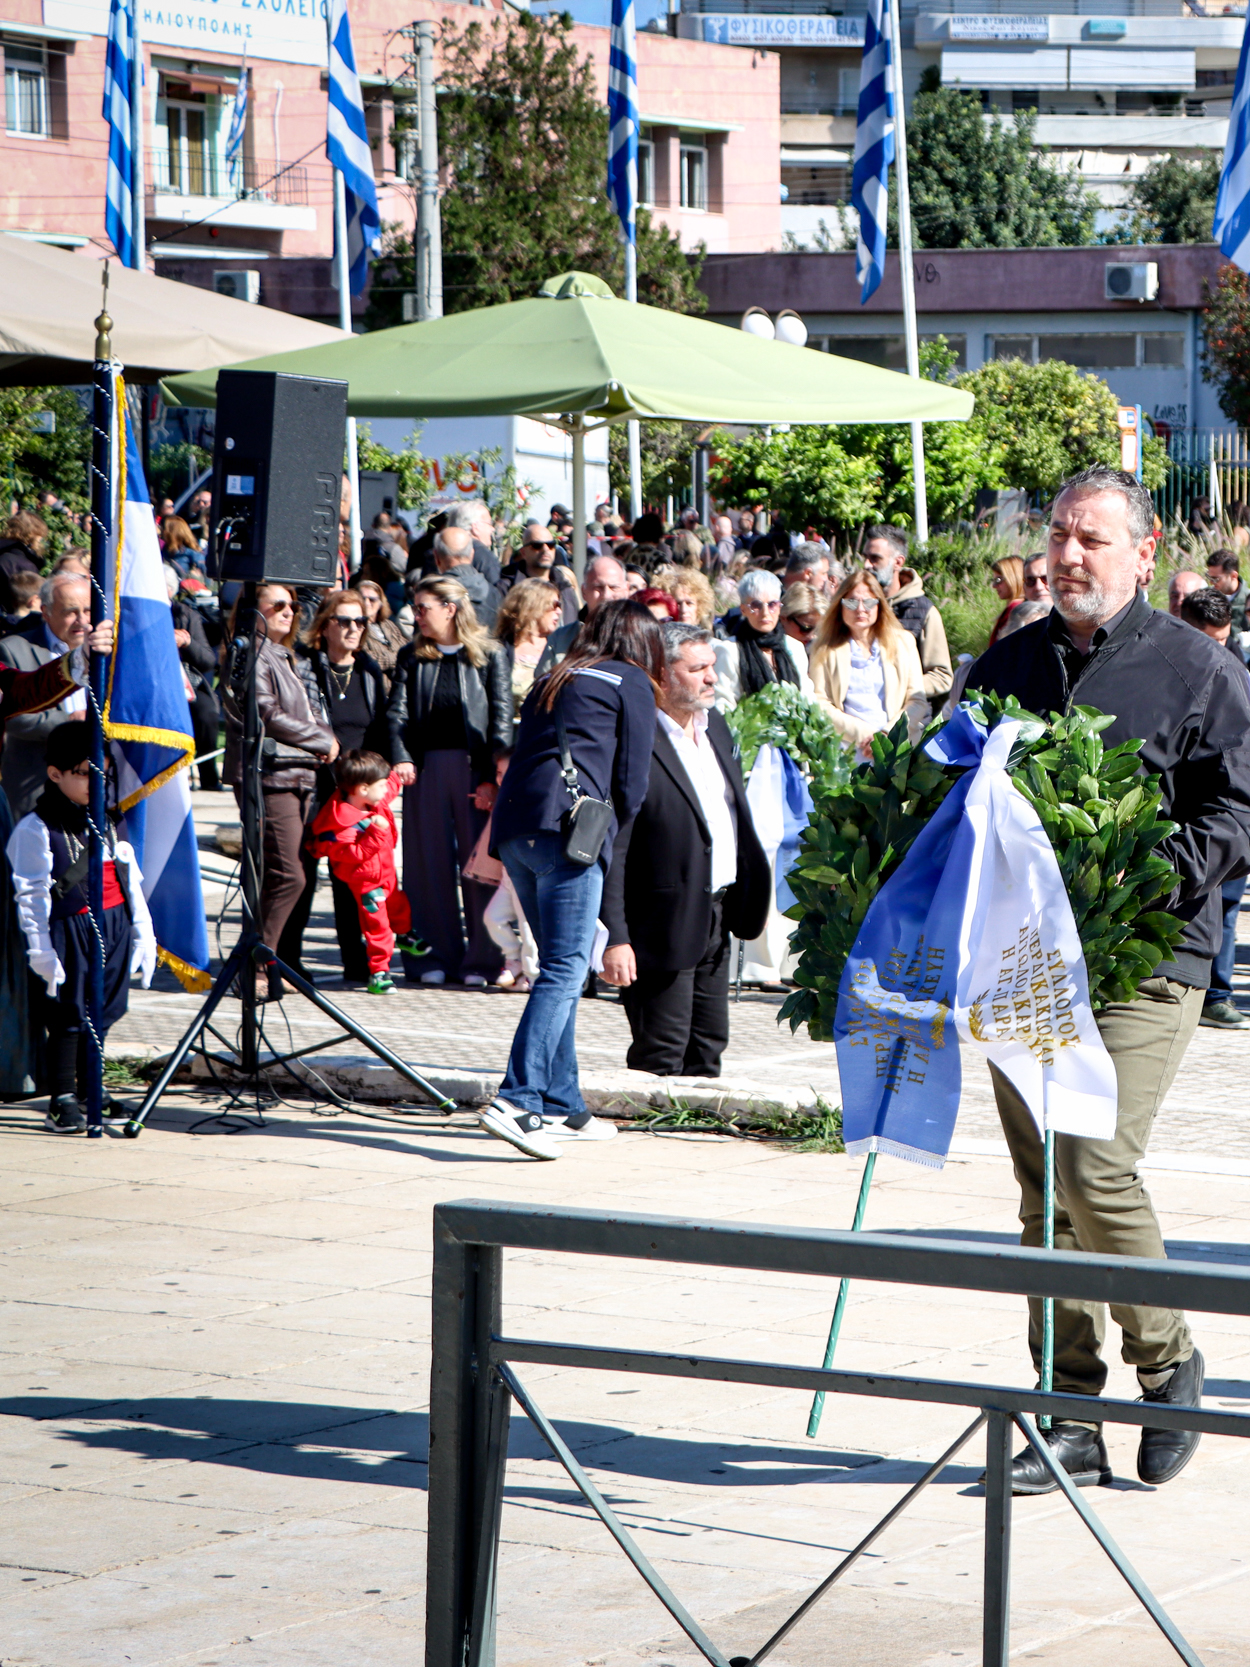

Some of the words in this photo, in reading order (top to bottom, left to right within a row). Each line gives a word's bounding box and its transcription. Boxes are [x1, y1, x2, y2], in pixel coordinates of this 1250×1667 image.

[144, 9, 253, 38] ΗΛΙΟΥΠΟΛΗΣ
[730, 17, 859, 35] ΦΥΣΙΚΟΘΕΡΑΠΕΙΑ
[1002, 945, 1015, 961] Η
[1028, 927, 1054, 1037] ΠΕΡΔΙΚΑΚΙΩ
[1046, 948, 1082, 1049] ΣΥΛΛΟΓΟΣ
[907, 1069, 926, 1085] Η
